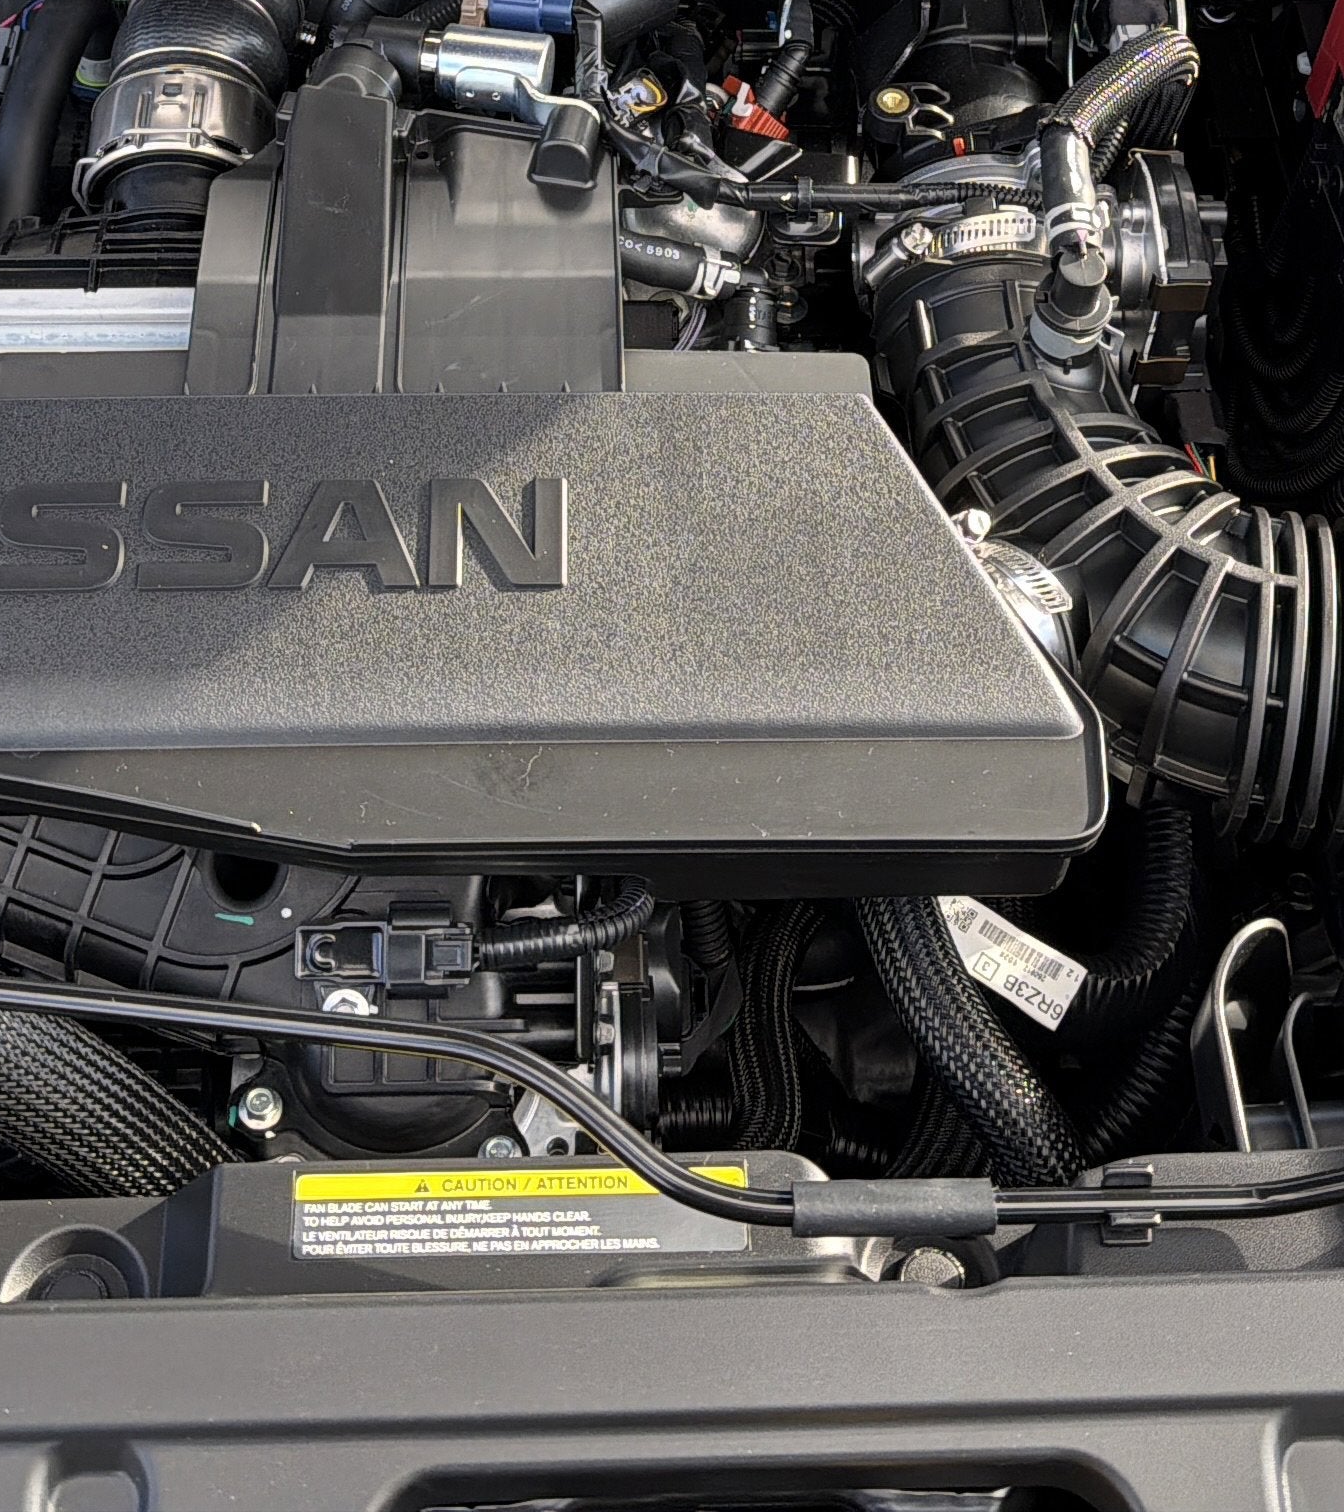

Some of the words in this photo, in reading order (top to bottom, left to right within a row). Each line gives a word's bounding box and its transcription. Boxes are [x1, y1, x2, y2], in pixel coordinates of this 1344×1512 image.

[1002, 974, 1065, 1021] 6RZ3B
[441, 1178, 517, 1192] CAUTION
[537, 1175, 629, 1190] ATTENTION
[304, 1202, 326, 1214] FAN
[327, 1201, 364, 1214] BLADE
[364, 1201, 389, 1213] CAN
[390, 1200, 425, 1212] START
[425, 1200, 440, 1211] AT
[441, 1199, 464, 1211] ANY
[302, 1216, 319, 1227] TO
[320, 1215, 350, 1227] HELP
[350, 1215, 385, 1226] AVOID
[385, 1213, 444, 1226] PERSONAL
[512, 1211, 552, 1223] HANDS
[302, 1231, 318, 1243] LE
[318, 1229, 389, 1242] VENTILATEUR
[389, 1228, 431, 1241] RISQUE
[432, 1228, 449, 1240] DE
[449, 1225, 510, 1239] DÉMARRER
[521, 1226, 551, 1238] TOUT
[301, 1244, 335, 1256] POUR
[374, 1242, 411, 1254] TOUTE
[472, 1240, 490, 1252] NE
[490, 1240, 513, 1252] PAS
[513, 1239, 531, 1251] EN
[531, 1238, 600, 1251] APPROCHER
[600, 1238, 621, 1250] LES
